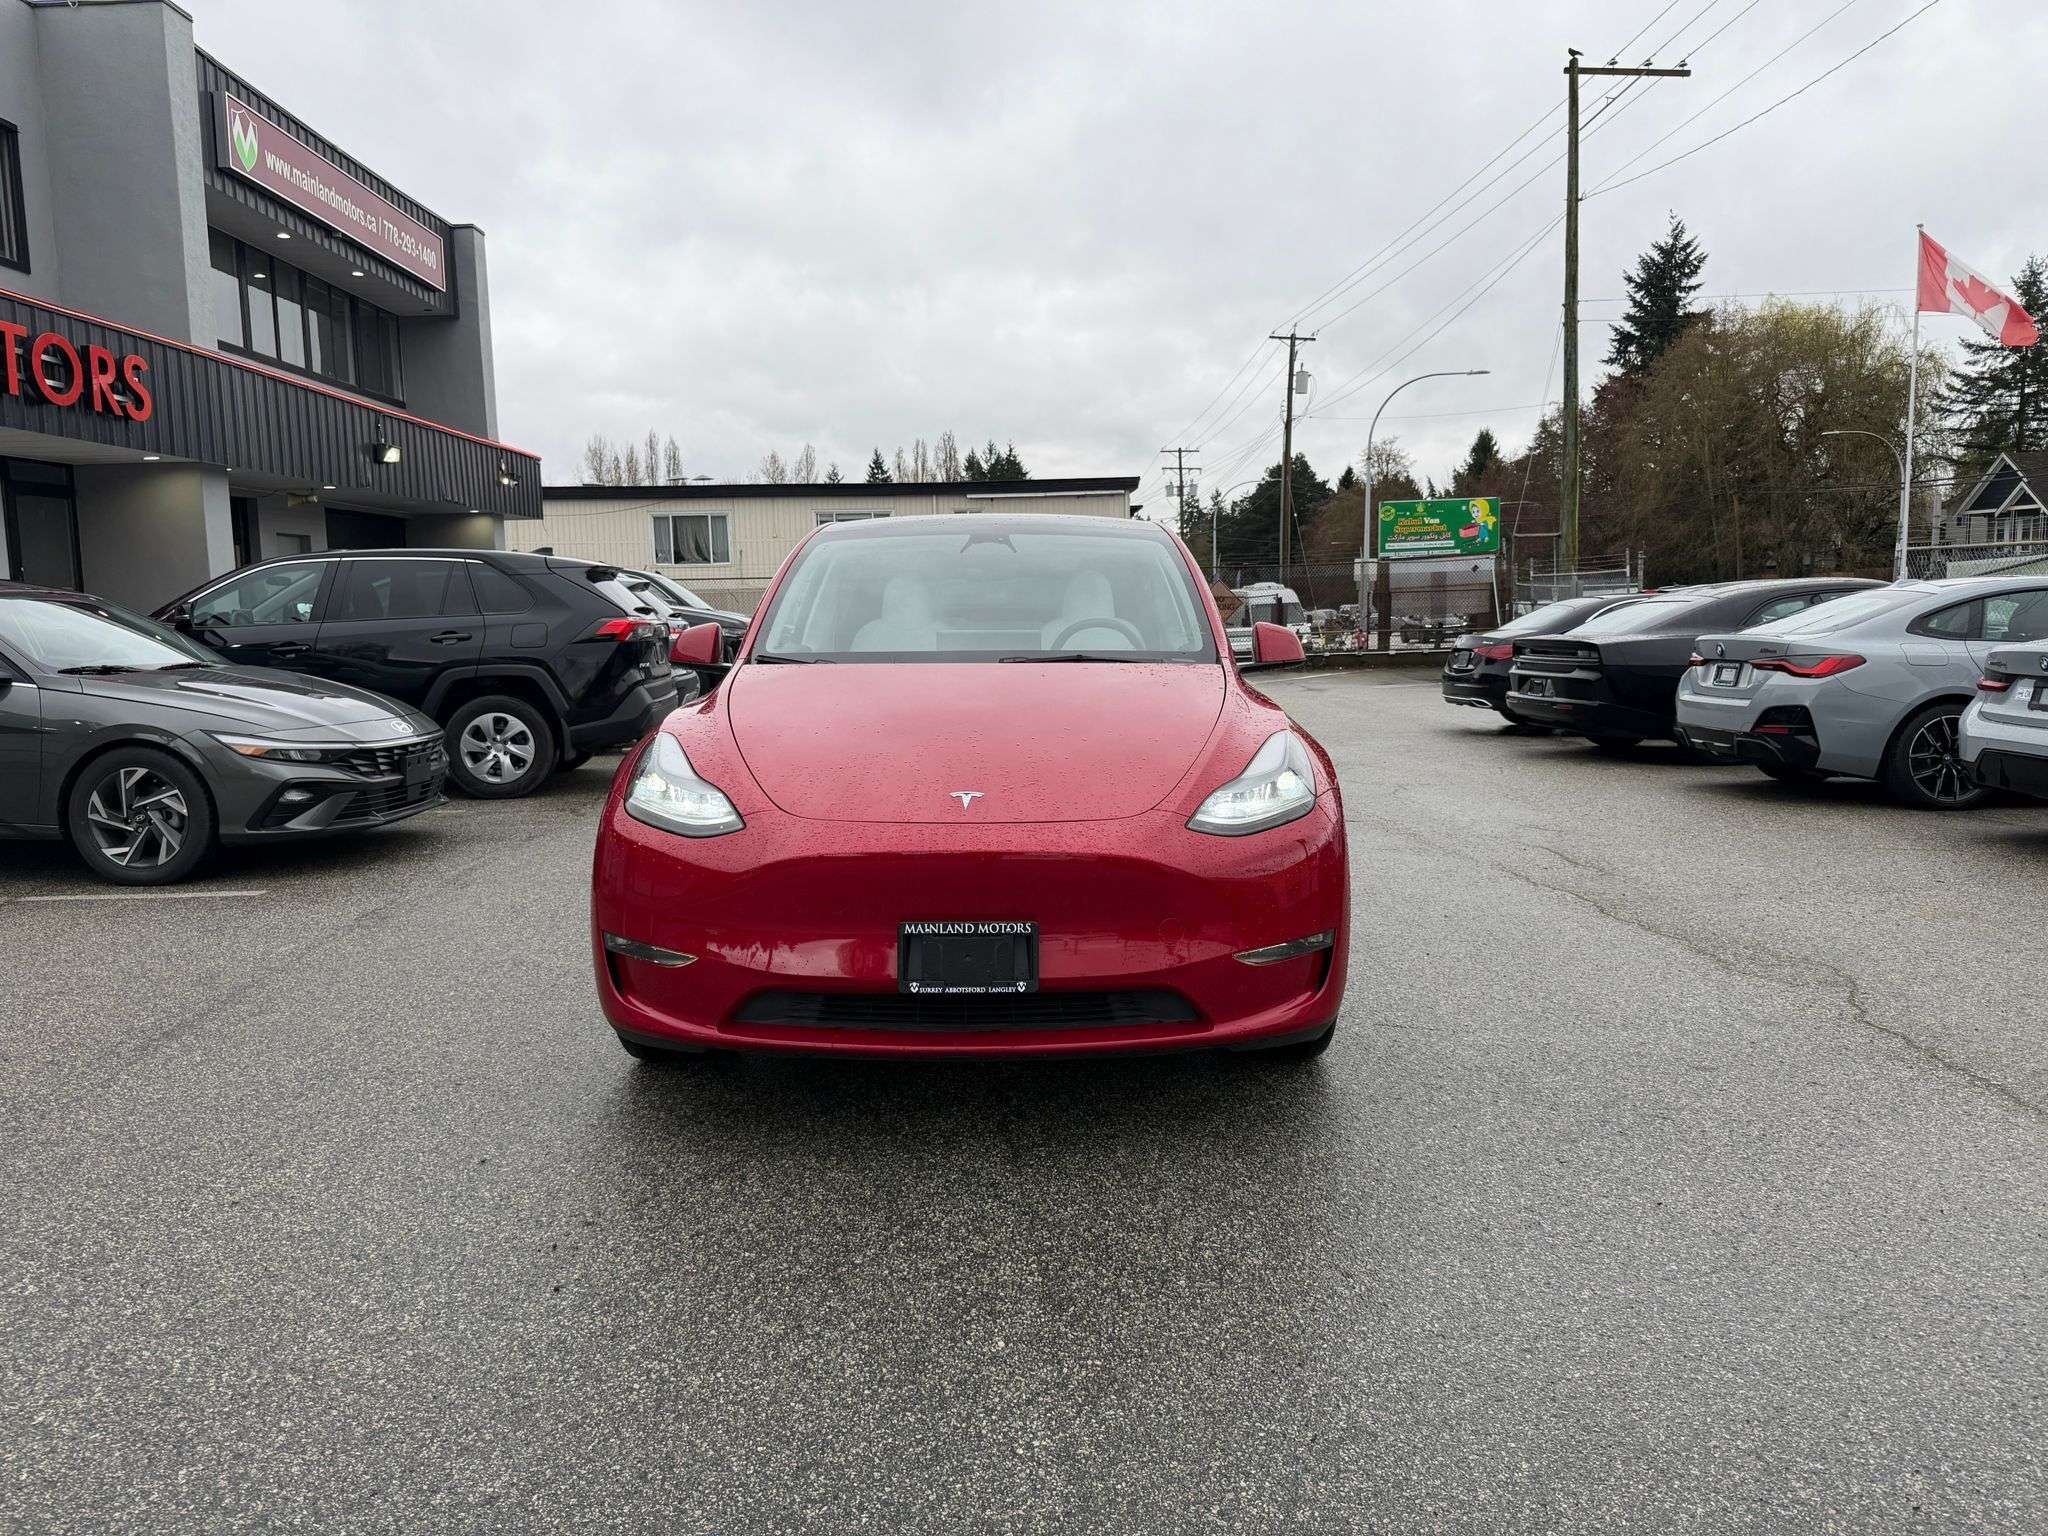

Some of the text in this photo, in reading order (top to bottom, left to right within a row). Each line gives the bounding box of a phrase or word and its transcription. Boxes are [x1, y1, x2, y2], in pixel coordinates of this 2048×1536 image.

[264, 149, 377, 233] www.mainlandmotors.ca
[383, 220, 437, 270] 778-293-1400
[904, 923, 1032, 934] MAINLAND MOTORS
